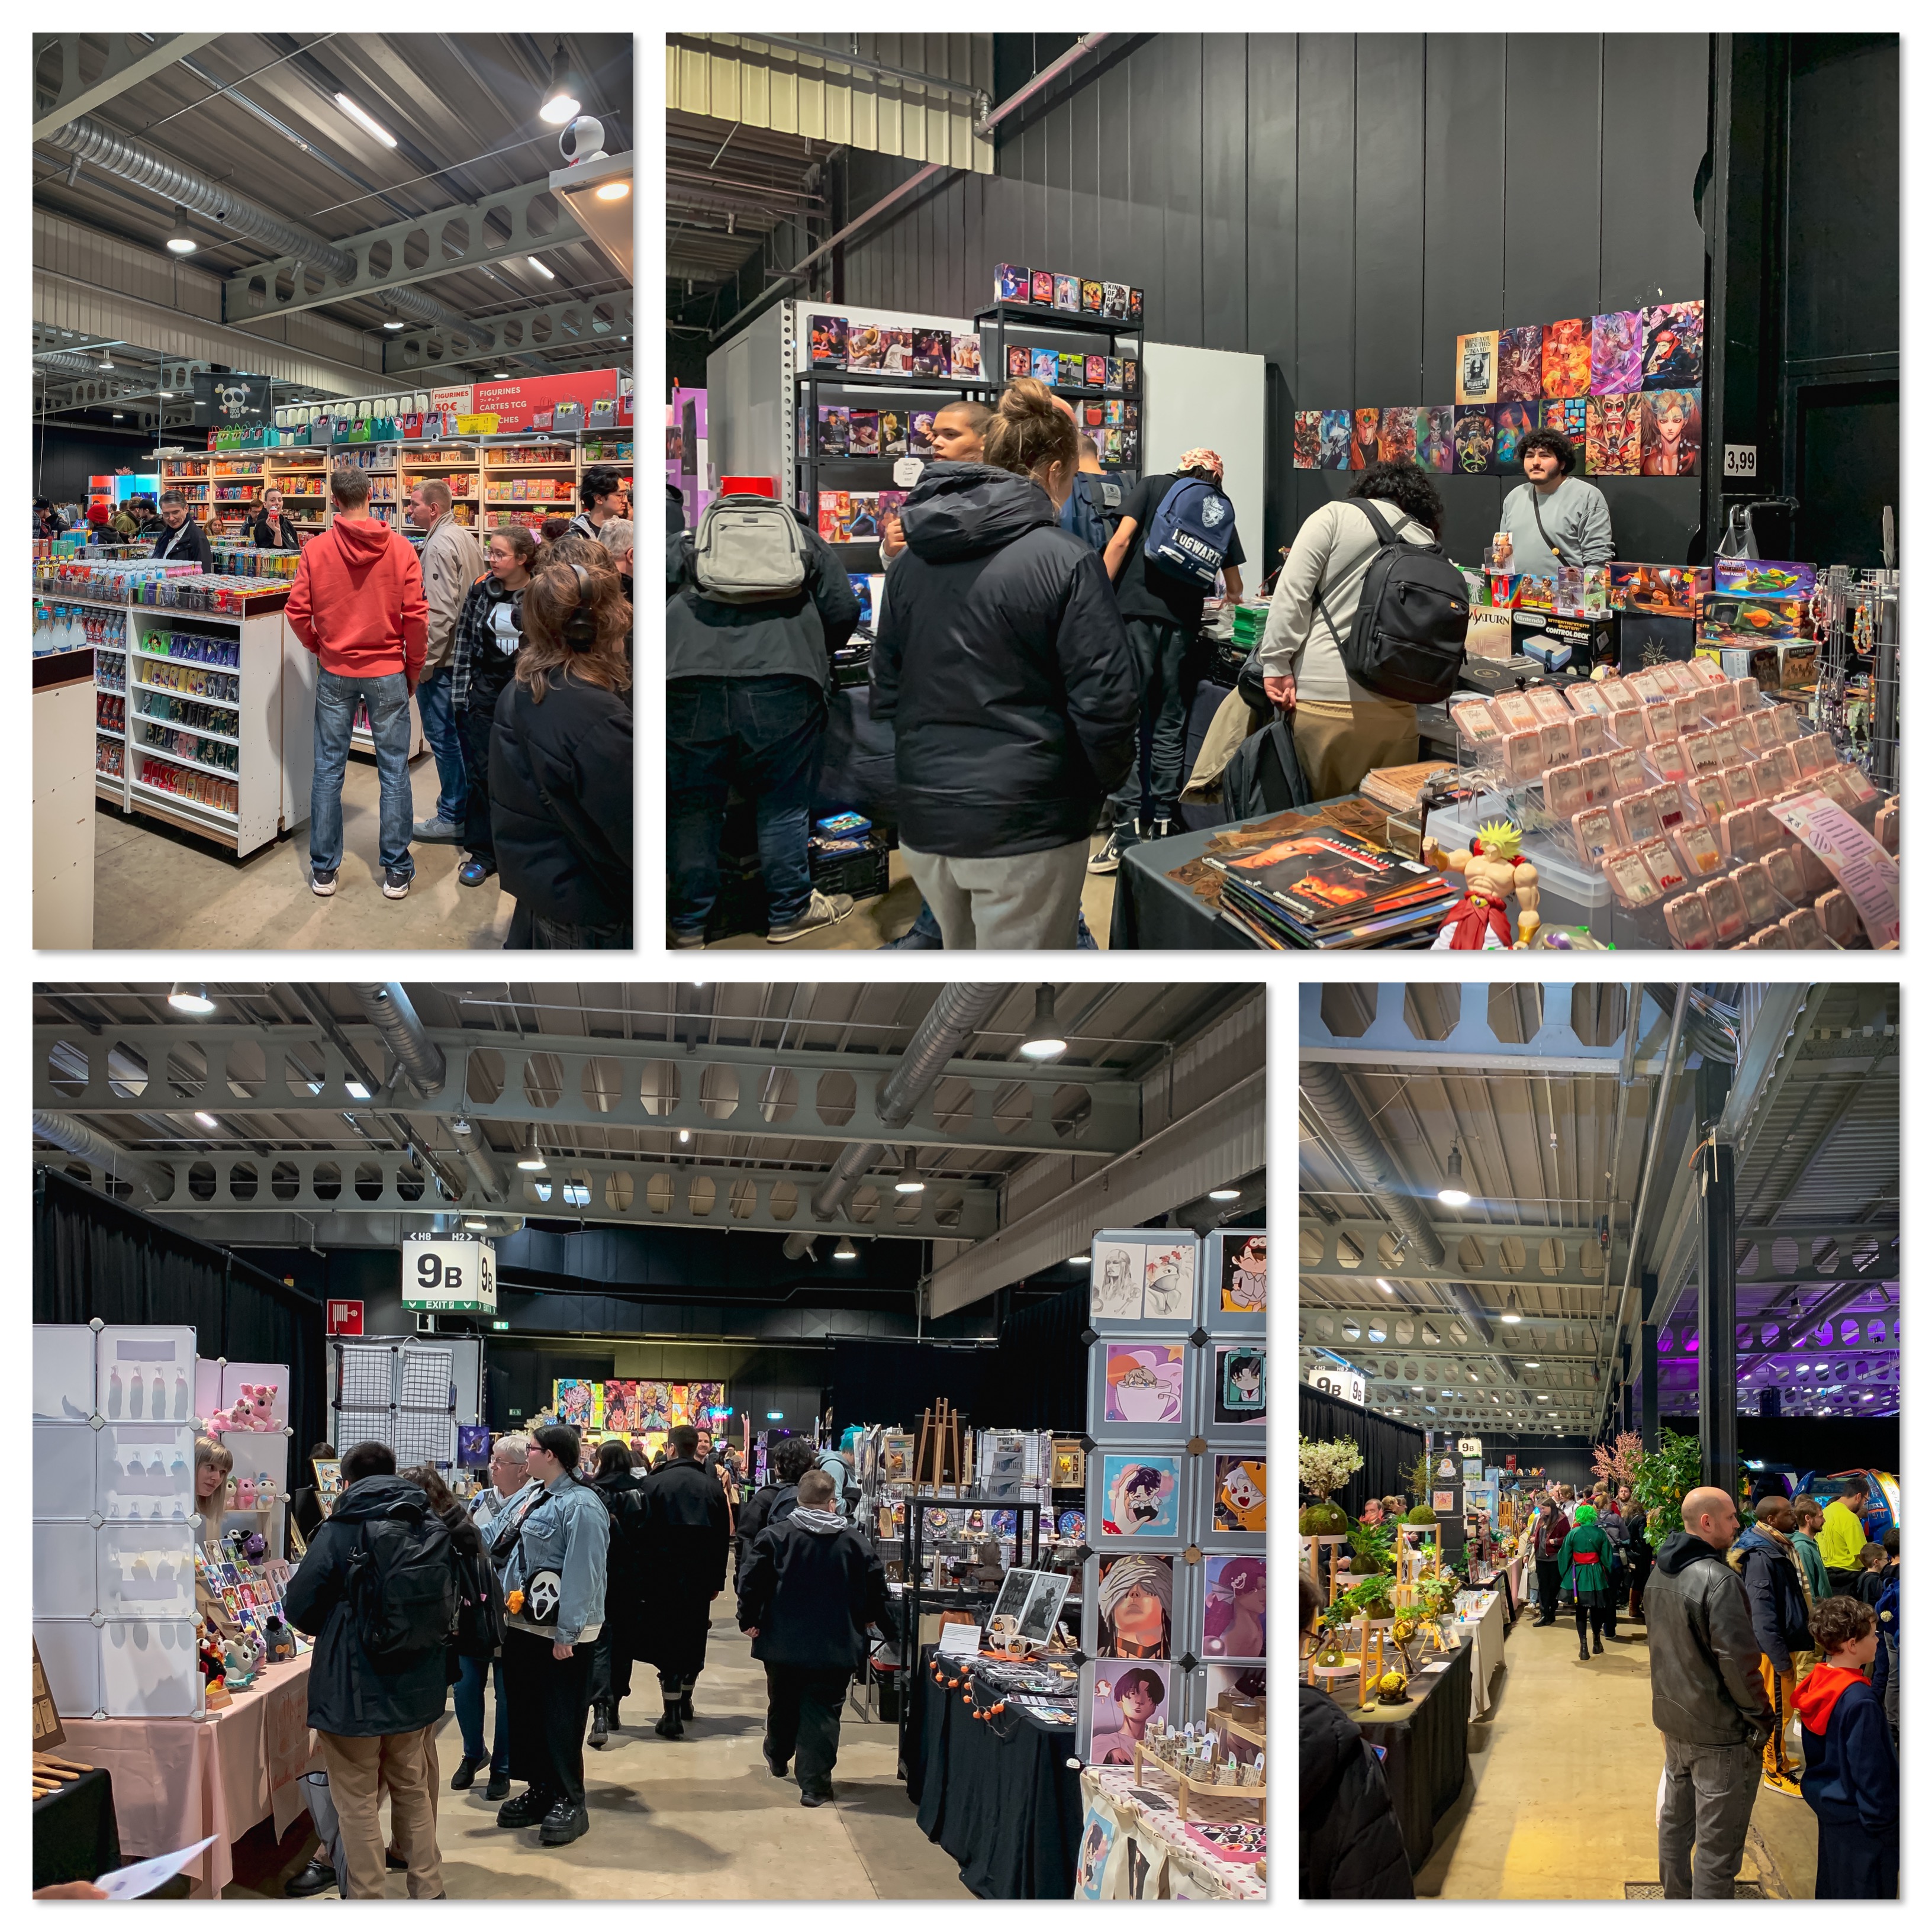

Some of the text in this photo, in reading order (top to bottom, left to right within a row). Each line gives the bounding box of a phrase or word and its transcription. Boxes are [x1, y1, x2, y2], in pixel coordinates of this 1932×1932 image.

[434, 391, 469, 400] FIGURINES
[479, 387, 521, 397] FIGURINES
[435, 402, 458, 412] 30€
[479, 402, 510, 411] CARTES
[1727, 450, 1755, 474] 3,99
[1516, 614, 1543, 625] Nintendo
[1547, 618, 1590, 629] ENTERTAINMENT
[1545, 626, 1589, 640] CONTROL DECK
[418, 1232, 432, 1241] H8
[417, 1253, 462, 1289] 9B
[481, 1257, 493, 1293] 9B
[1316, 1377, 1341, 1396] 9B
[1353, 1381, 1362, 1402] 9B
[1462, 1443, 1474, 1452] 9B
